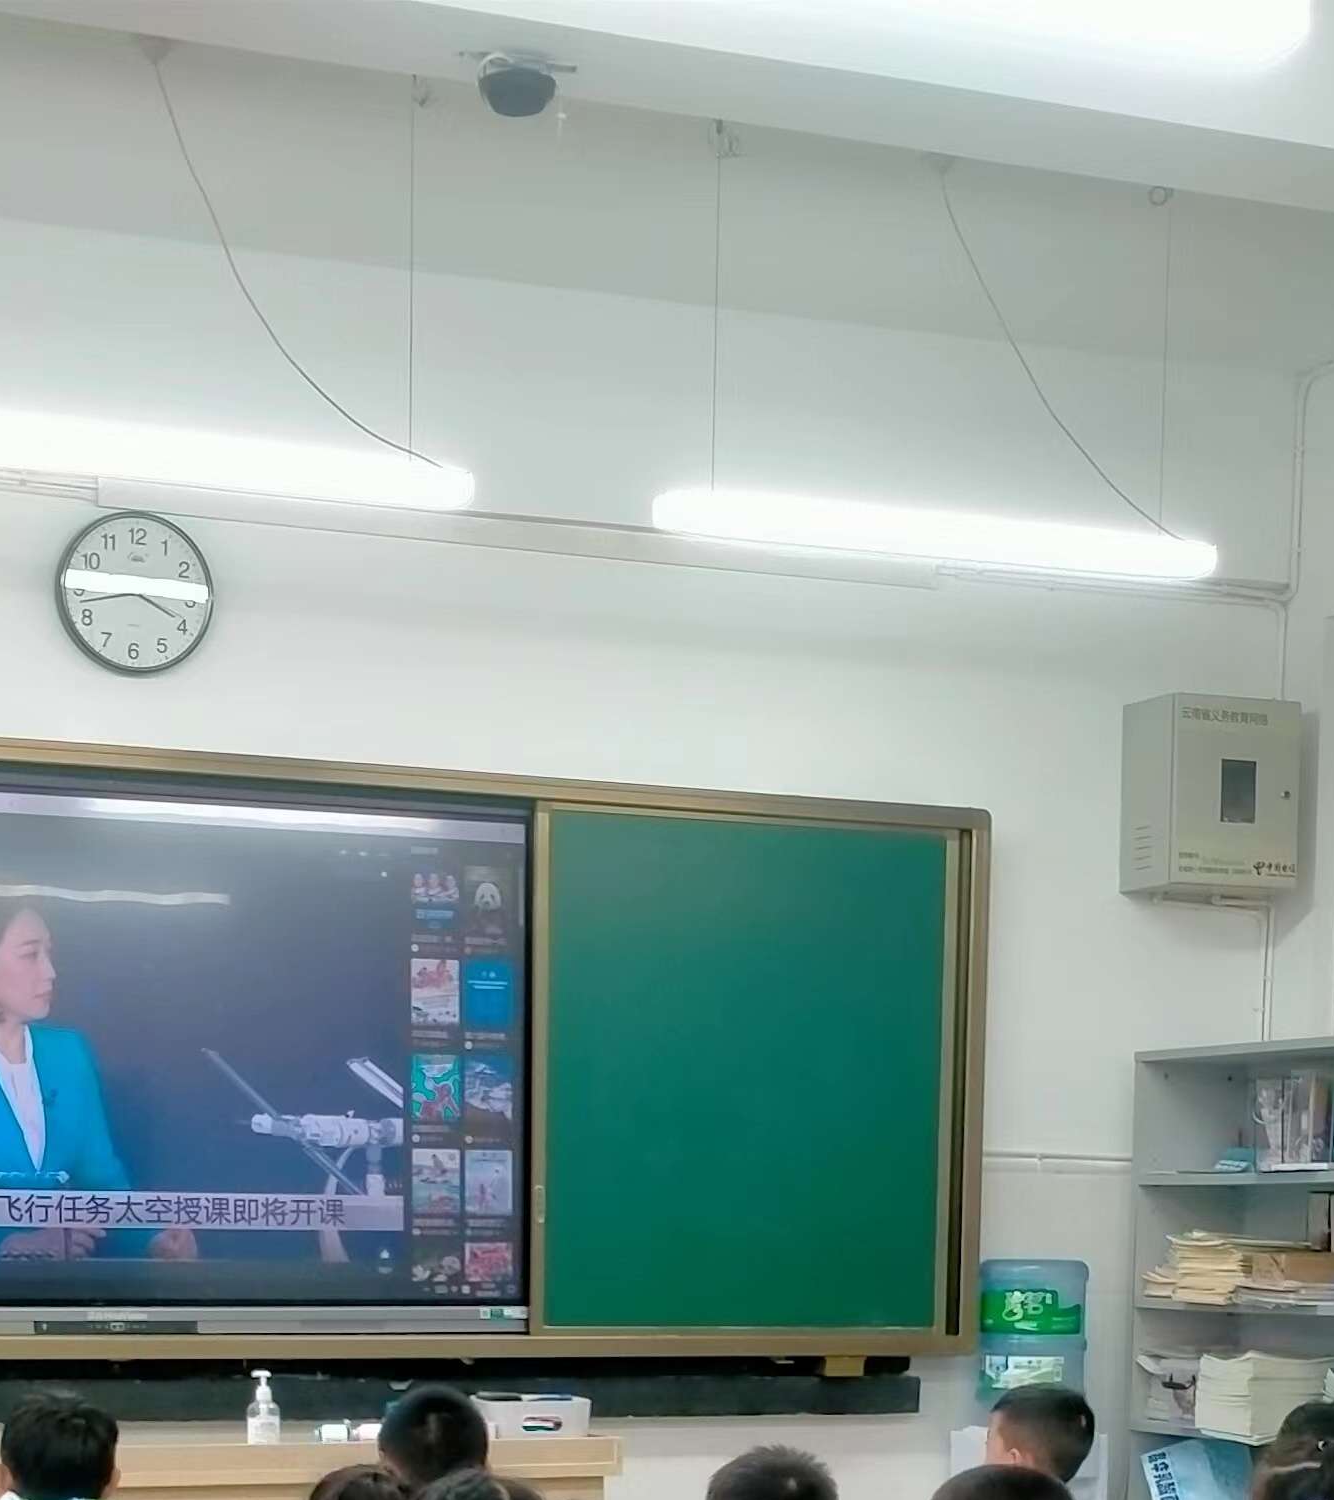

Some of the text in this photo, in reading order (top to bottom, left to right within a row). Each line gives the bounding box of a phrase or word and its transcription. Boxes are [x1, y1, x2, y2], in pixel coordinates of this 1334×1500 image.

[101, 533, 117, 551] 11
[128, 528, 147, 546] 12
[161, 539, 168, 556] 1
[82, 552, 100, 570] 10
[178, 561, 190, 578] 2
[81, 609, 93, 626] 8
[177, 619, 188, 635] 4
[101, 631, 113, 647] 7
[157, 638, 168, 654] 5
[128, 643, 139, 659] 6
